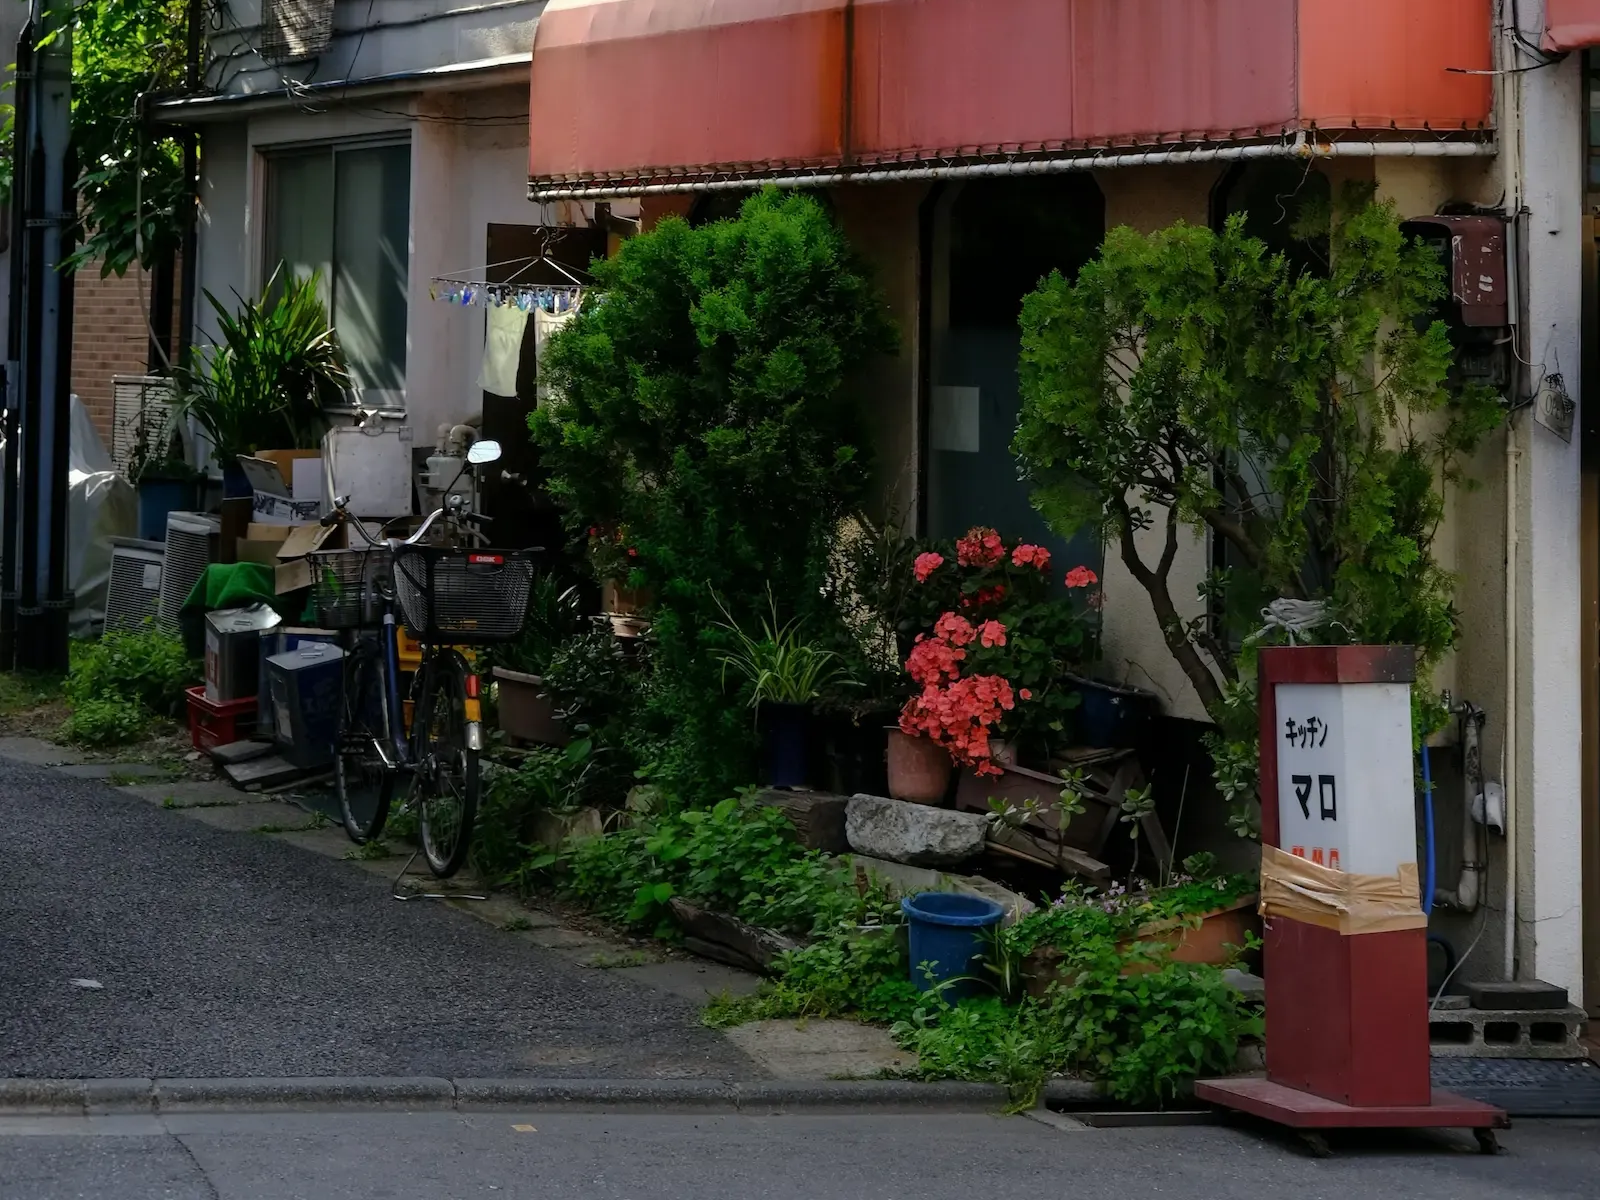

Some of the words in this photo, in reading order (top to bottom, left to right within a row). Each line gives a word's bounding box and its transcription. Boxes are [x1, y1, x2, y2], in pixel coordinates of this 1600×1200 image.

[1285, 716, 1328, 748] キッチン
[1291, 774, 1337, 821] マロ
